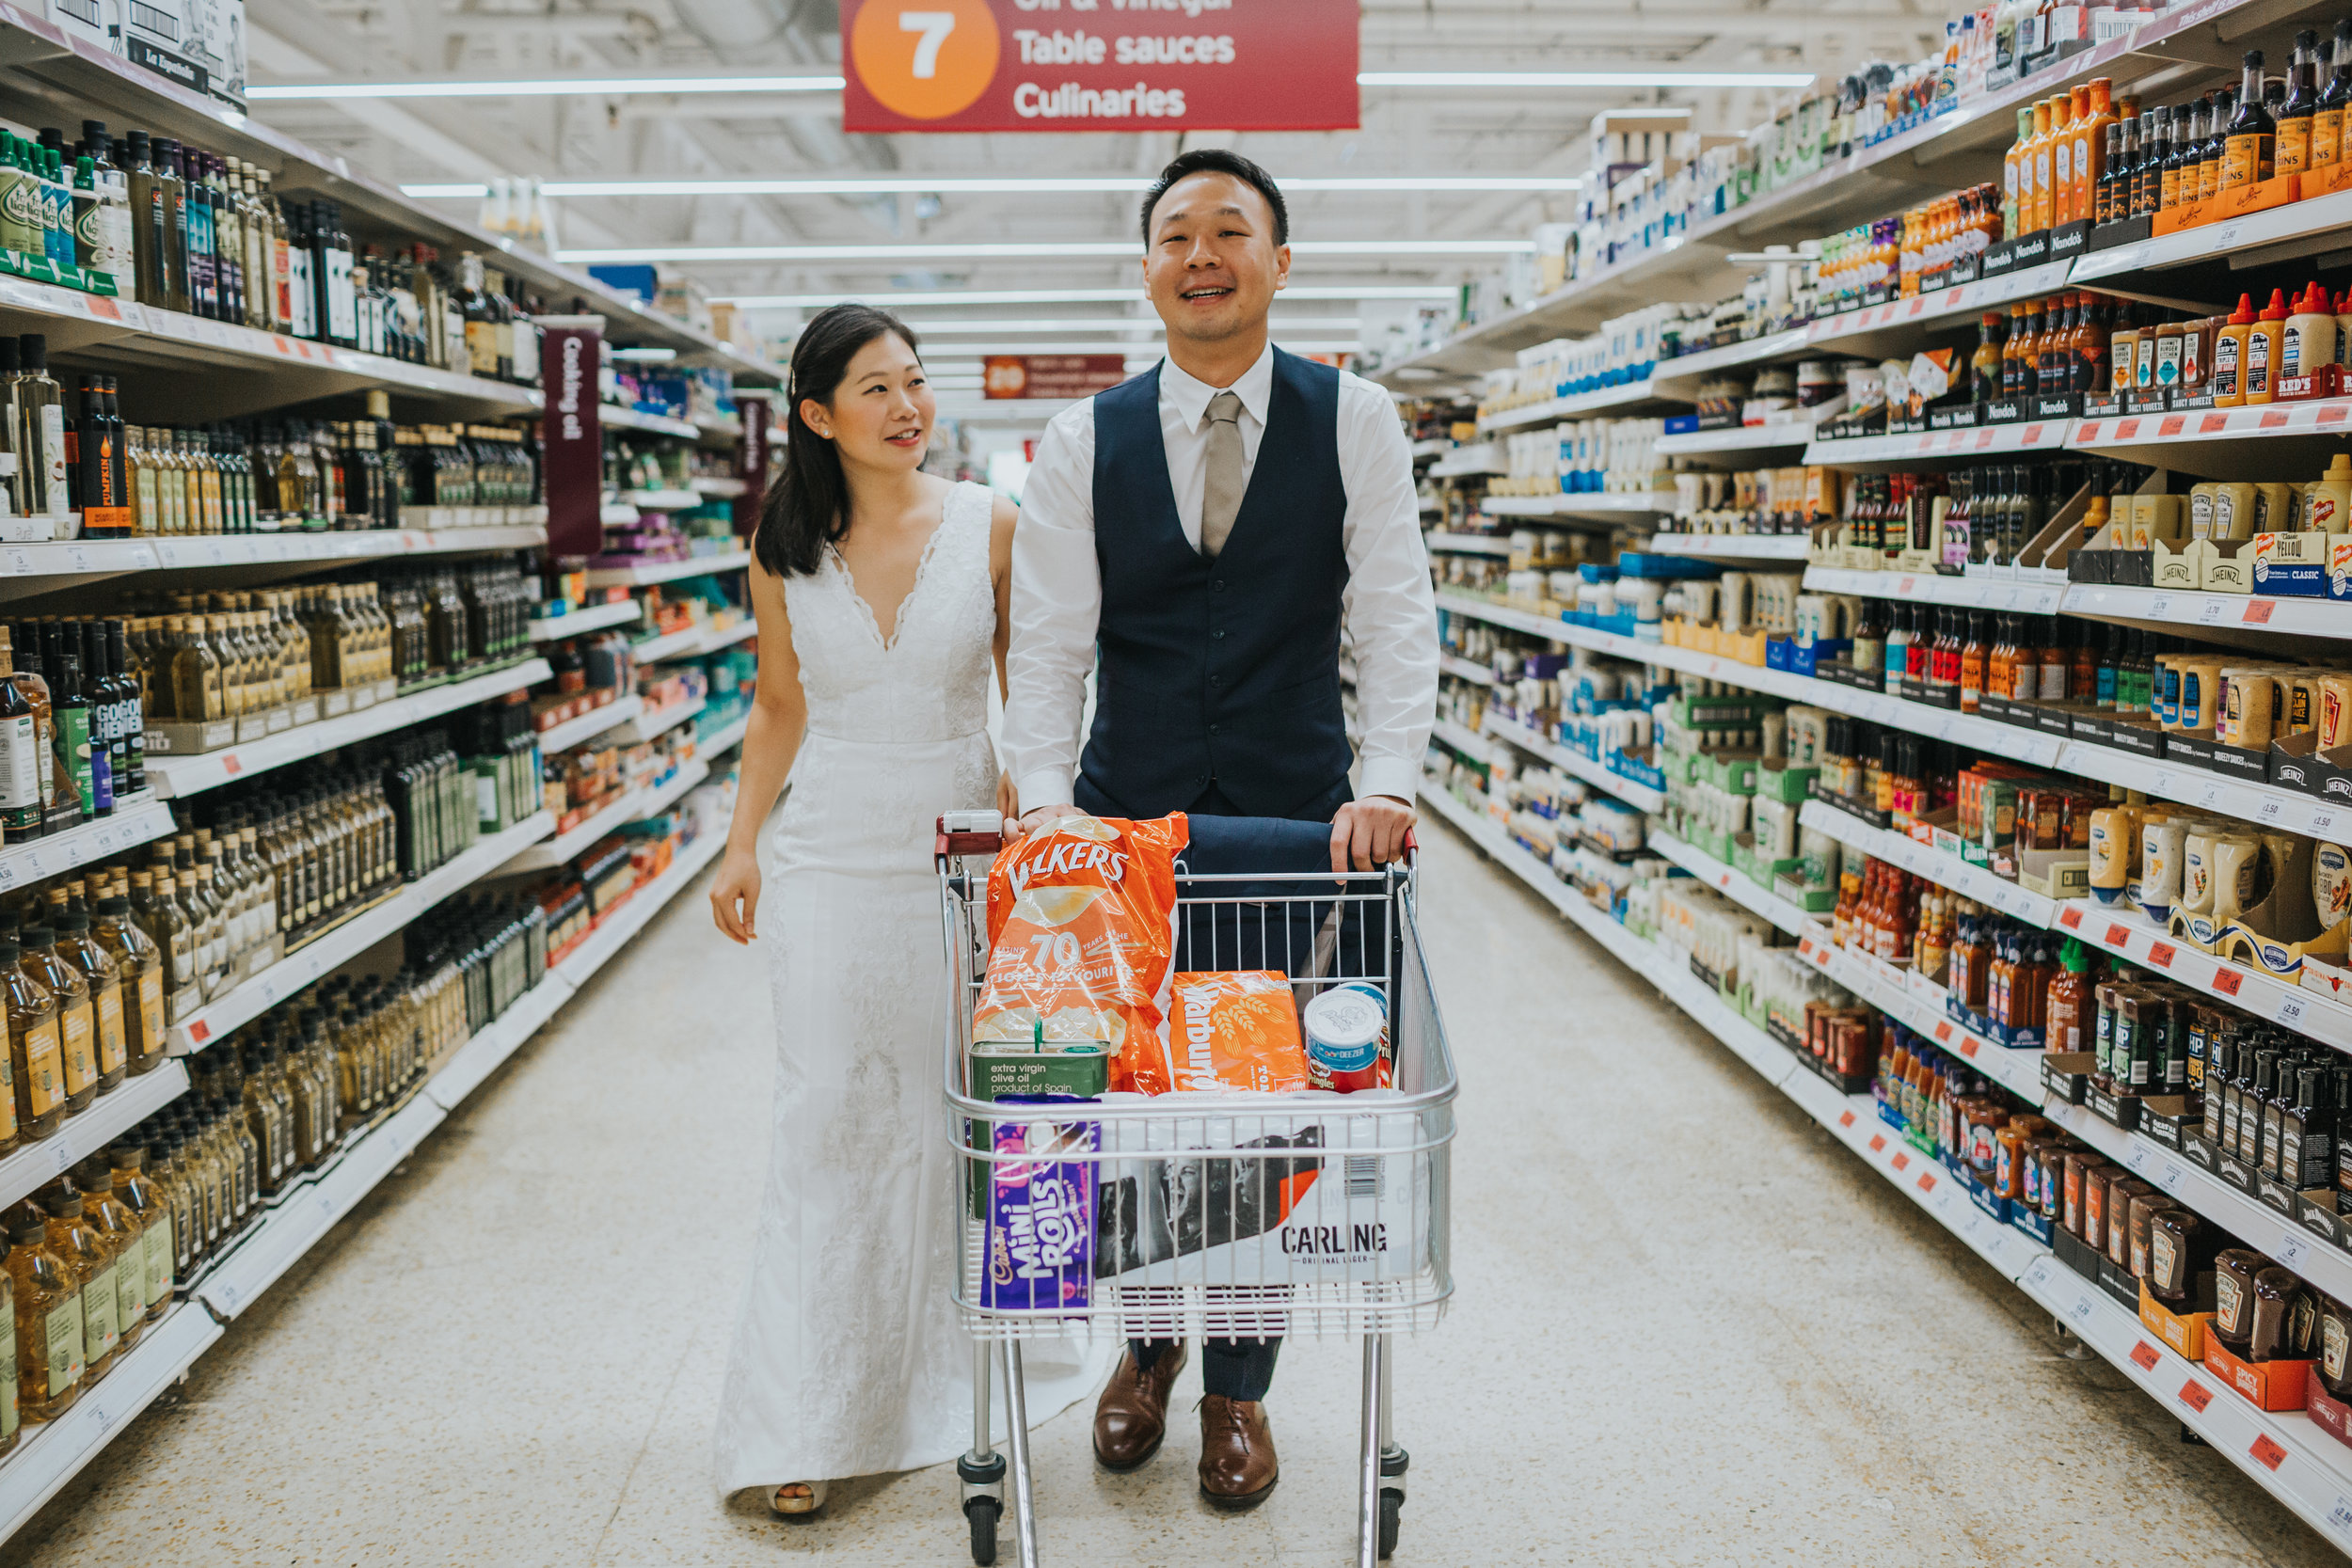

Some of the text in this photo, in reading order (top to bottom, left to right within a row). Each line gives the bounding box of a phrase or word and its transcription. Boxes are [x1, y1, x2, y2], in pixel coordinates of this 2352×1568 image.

[898, 10, 956, 79] 7
[1012, 29, 1236, 65] Table sauces
[1013, 81, 1186, 119] Culinaries
[2015, 239, 2045, 260] Nando's
[2052, 231, 2083, 251] Nando's
[557, 337, 584, 440] Cooking oil
[2278, 377, 2312, 393] RED'S
[1988, 403, 2018, 420] Nando's
[2040, 399, 2070, 415] Nando's
[100, 458, 112, 507] PUMPKIN
[2277, 540, 2303, 559] YELLOW
[2166, 568, 2185, 579] HEINZ
[2215, 570, 2236, 583] HEINZ
[2292, 570, 2320, 580] CLASSIC
[2282, 768, 2302, 784] HEINZ
[2328, 781, 2351, 797] HEINZ
[2313, 816, 2331, 828] £1.50
[1008, 841, 1130, 900] WLKERS
[1029, 931, 1082, 968] 70
[1082, 935, 1104, 950] YEARS
[2282, 1004, 2300, 1017] £2.50
[1182, 982, 1221, 1092] Warburto
[2188, 1036, 2205, 1055] HP
[1340, 1048, 1365, 1059] DEEZER
[991, 1064, 1047, 1075] extra virgin
[991, 1073, 1030, 1083] olive oil
[991, 1084, 1073, 1094] product of Spain
[1307, 1071, 1335, 1089] Pringles
[1280, 1223, 1388, 1255] CARLING
[2287, 1247, 2297, 1259] £2
[2212, 1355, 2230, 1375] HEINZ
[2235, 1365, 2259, 1386] SPICY
[2315, 1402, 2336, 1425] HEINZ
